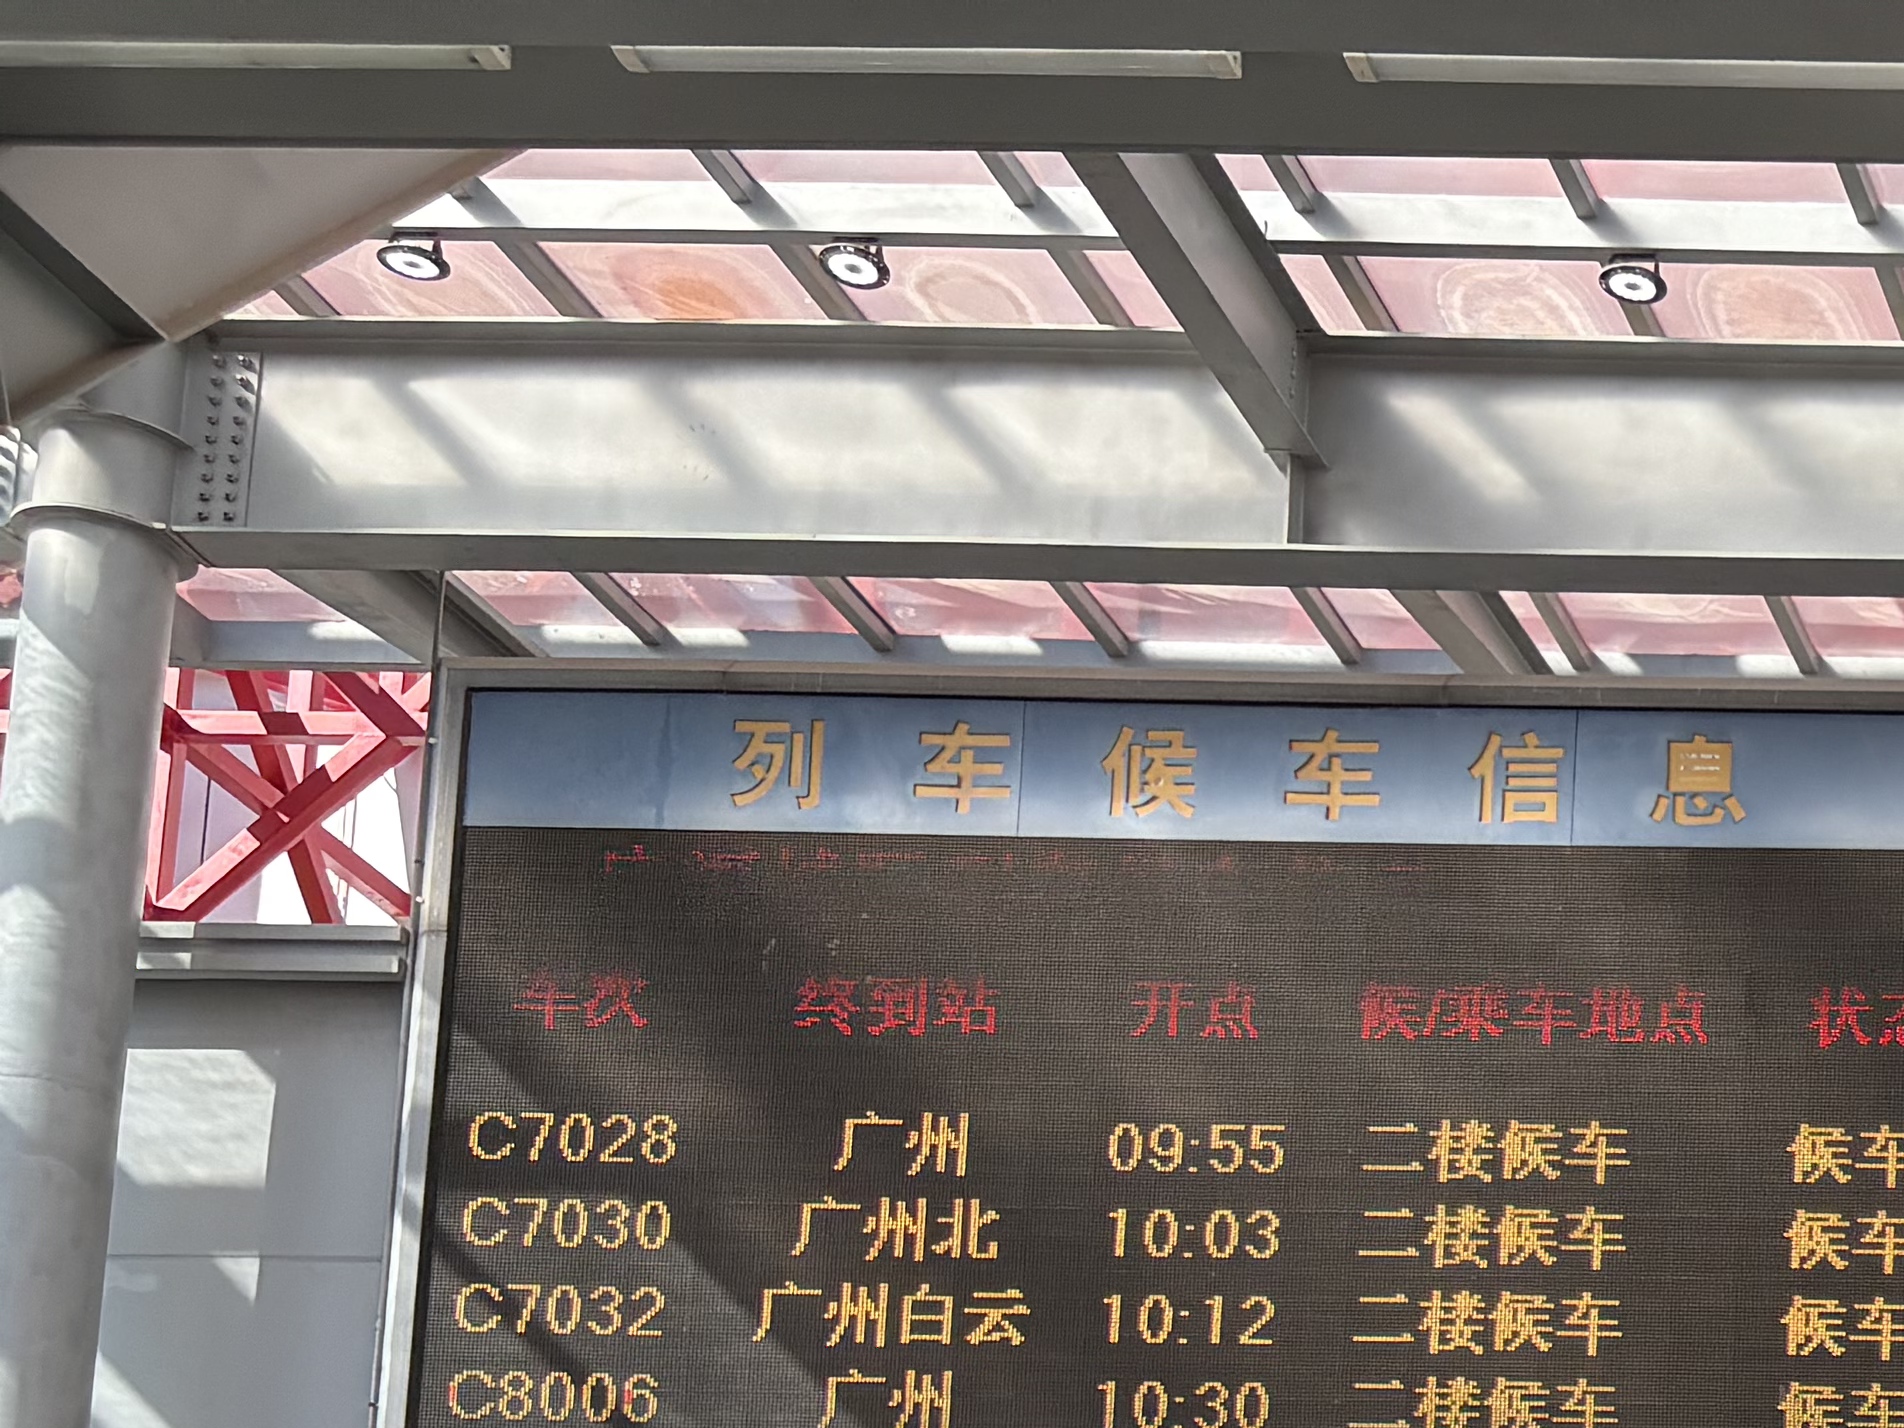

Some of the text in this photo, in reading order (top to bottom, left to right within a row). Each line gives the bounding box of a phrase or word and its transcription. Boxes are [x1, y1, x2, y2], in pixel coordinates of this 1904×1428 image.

[731, 718, 1747, 827] 列车候车信息
[513, 975, 648, 1032] 车次
[793, 975, 997, 1036] 终到站
[1130, 978, 1259, 1040] 开点
[1358, 980, 1708, 1046] 候/乘车地点
[469, 1113, 678, 1165] C7028
[835, 1113, 969, 1177] 广州
[1109, 1124, 1284, 1174] 09:55
[1364, 1121, 1629, 1185] 二楼候车
[463, 1198, 671, 1251] C7030
[793, 1197, 999, 1262] 广州北
[1110, 1210, 1280, 1259] 10:03
[1360, 1206, 1625, 1271] 二楼候车
[456, 1284, 665, 1338] C7032
[755, 1283, 1030, 1348] 广州白云
[1105, 1295, 1275, 1346] 10:12
[1353, 1291, 1621, 1357] 二楼候车
[448, 1373, 658, 1423] C8006
